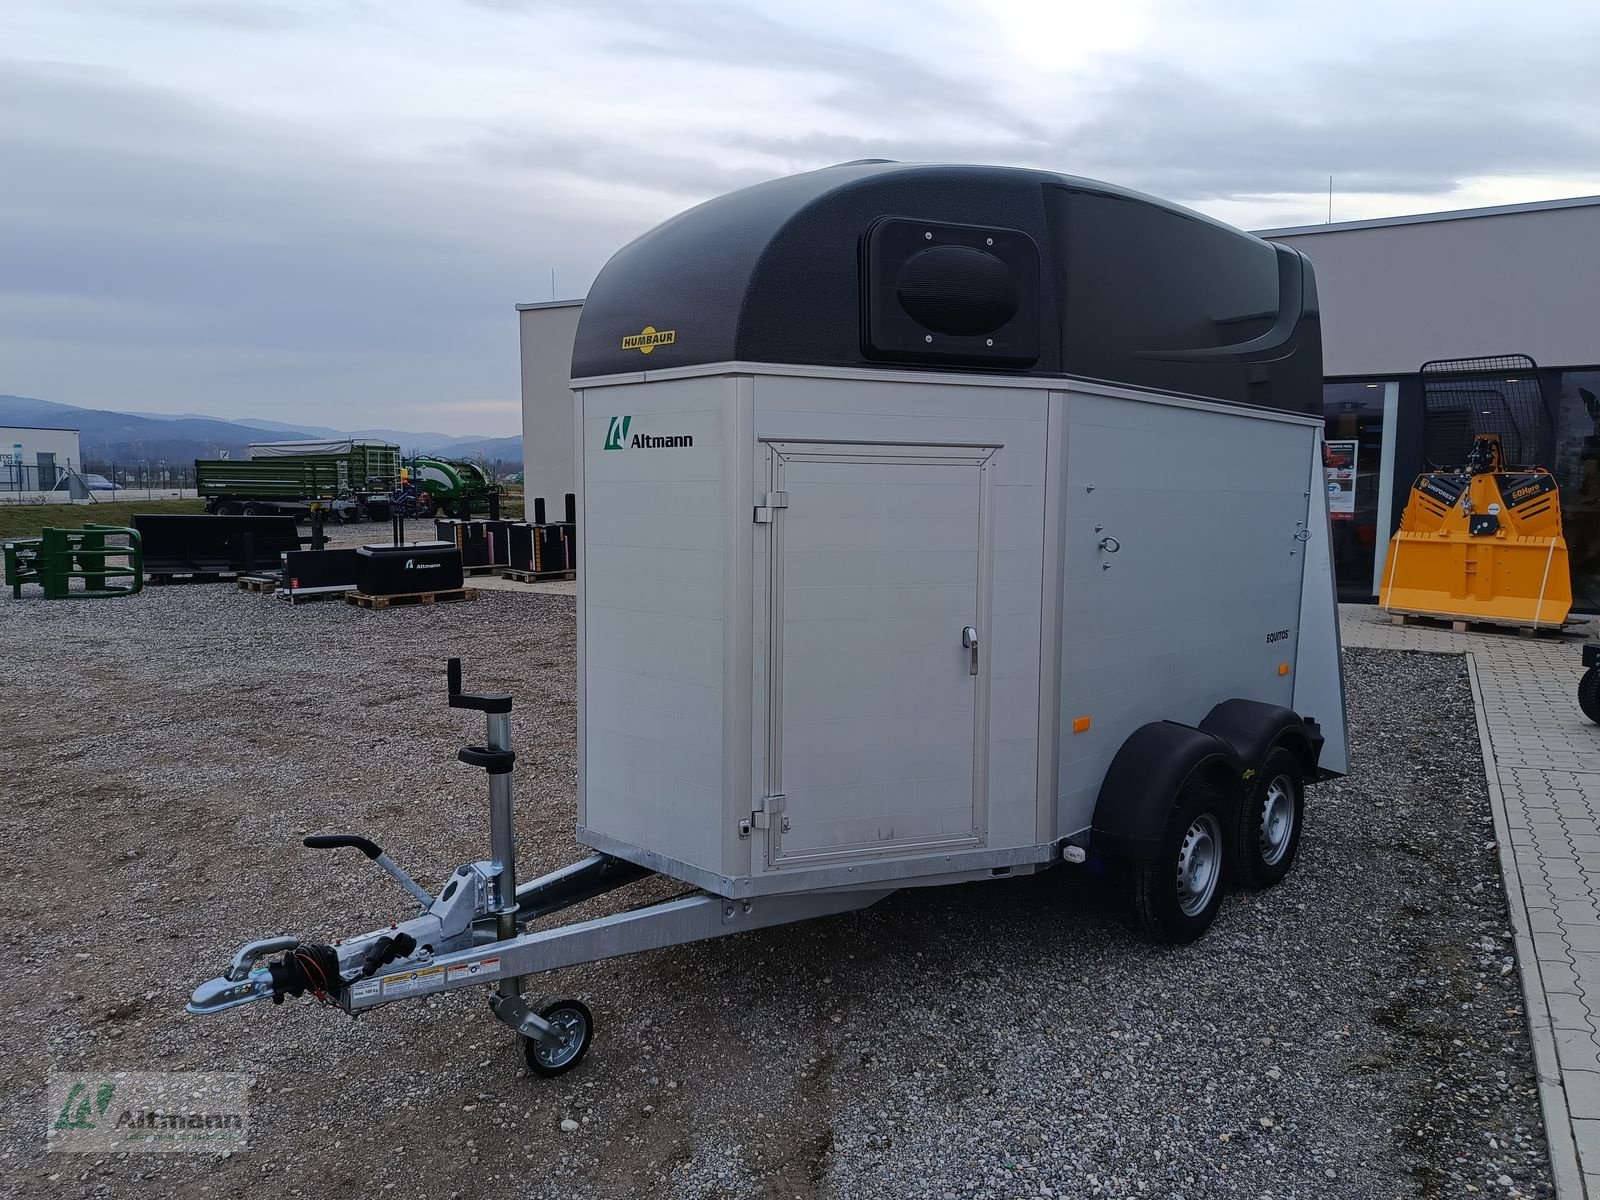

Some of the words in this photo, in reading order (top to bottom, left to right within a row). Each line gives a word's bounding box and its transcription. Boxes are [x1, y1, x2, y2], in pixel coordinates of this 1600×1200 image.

[624, 333, 673, 348] HUMBAUR
[631, 433, 693, 449] Altmann
[1427, 483, 1457, 502] UNIFOREST
[1266, 629, 1289, 644] EQUITOS
